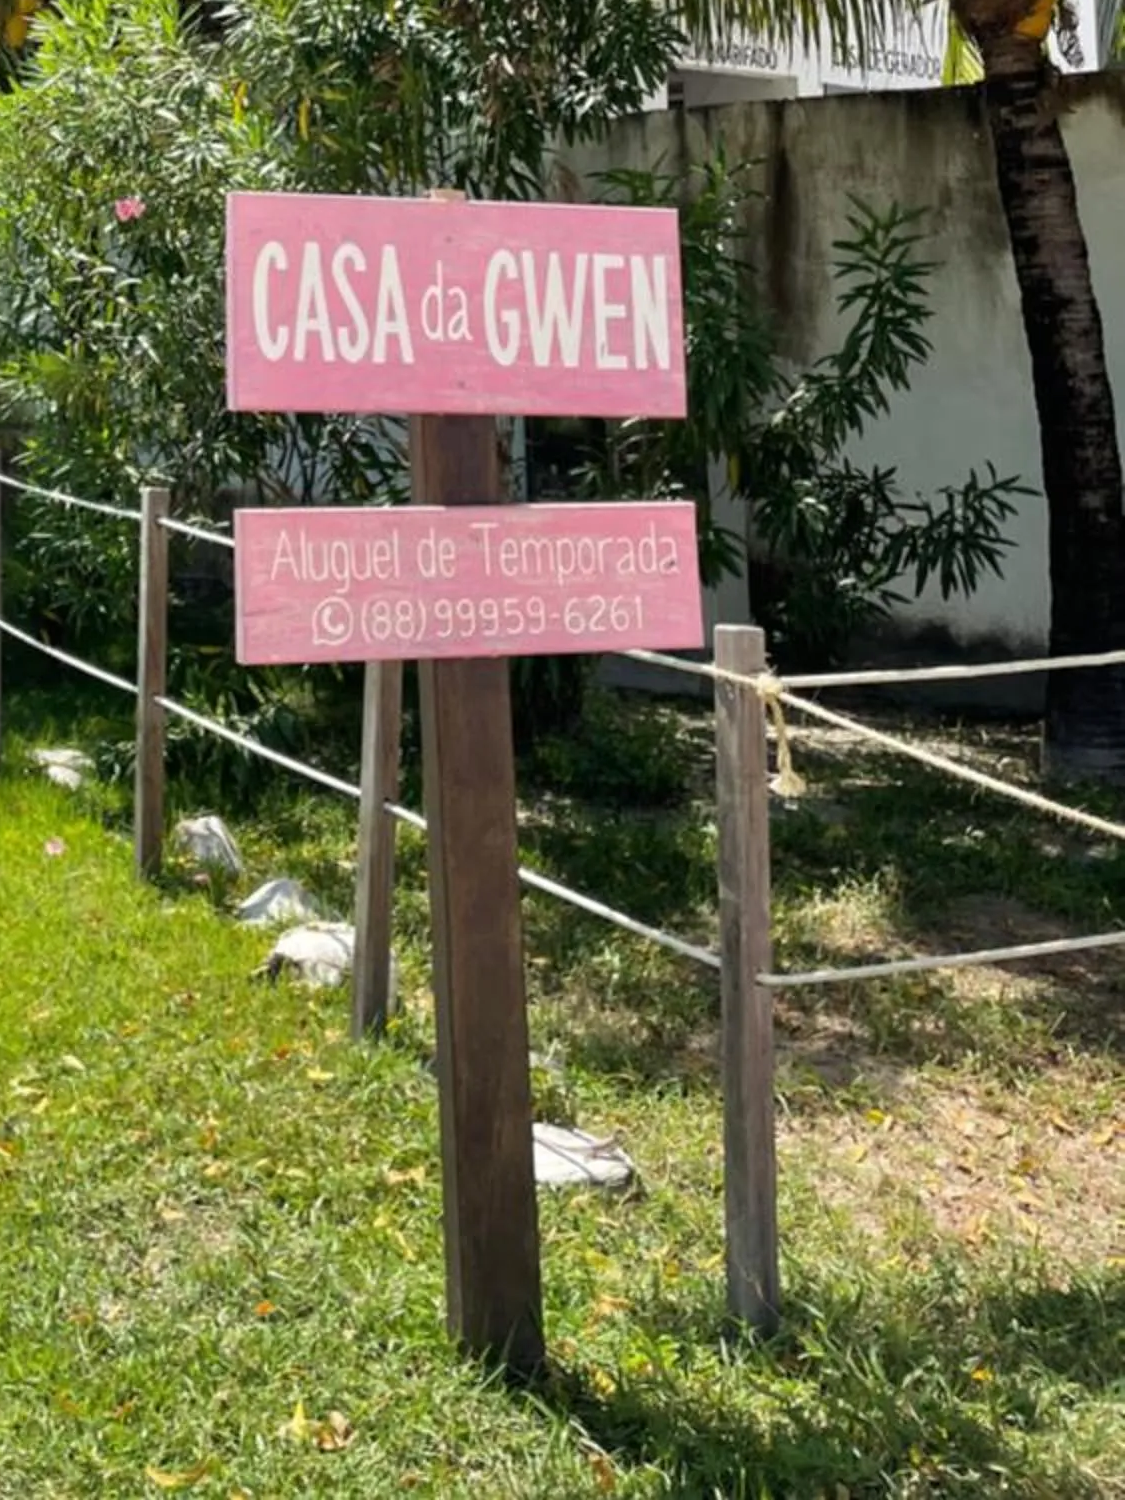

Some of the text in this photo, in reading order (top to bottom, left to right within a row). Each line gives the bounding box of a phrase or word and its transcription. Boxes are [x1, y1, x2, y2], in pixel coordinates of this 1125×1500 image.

[252, 240, 671, 371] CASA da GWEN
[270, 521, 681, 594] Aluguel de Temporada
